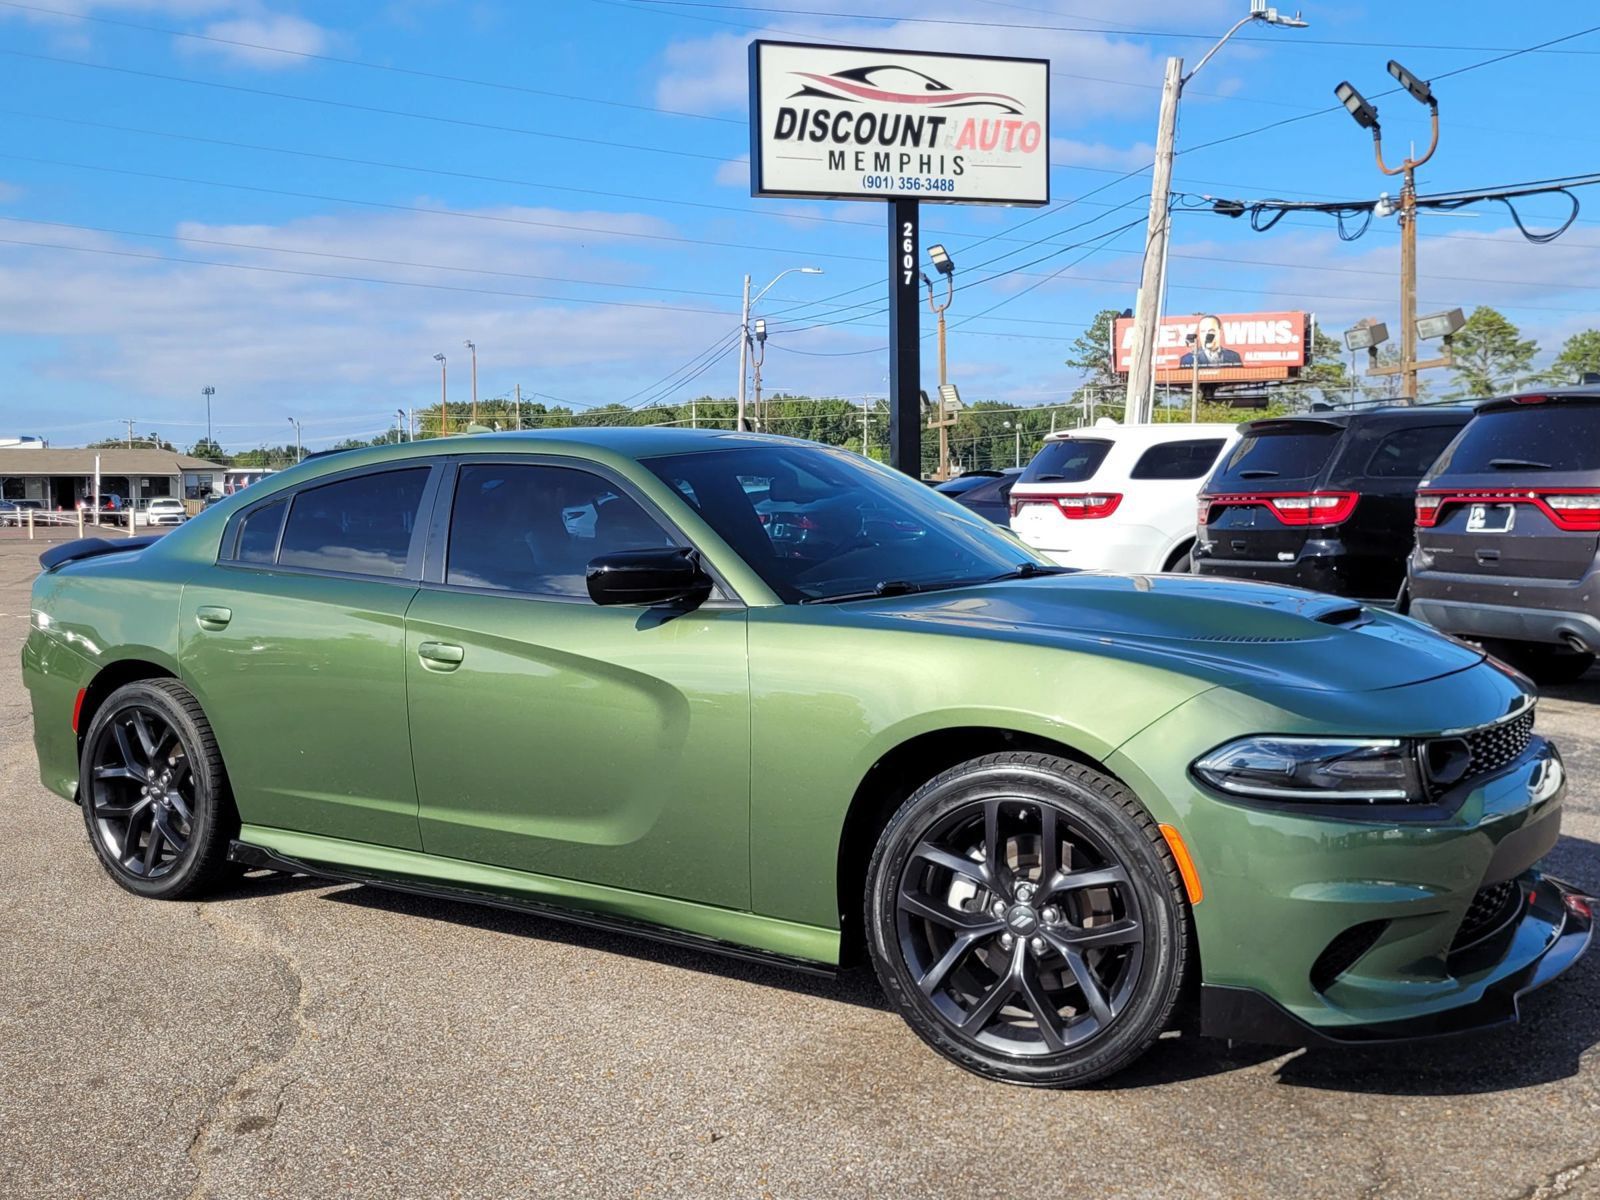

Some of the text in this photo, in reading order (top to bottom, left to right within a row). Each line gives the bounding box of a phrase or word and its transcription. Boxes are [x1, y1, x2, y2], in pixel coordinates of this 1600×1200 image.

[773, 107, 1041, 154] DISCOUNT AUTO
[828, 150, 965, 176] MEMPHIS
[862, 175, 955, 192] (901) 356-3488
[903, 222, 913, 285] 2607
[1121, 319, 1300, 349] AEX WINS.
